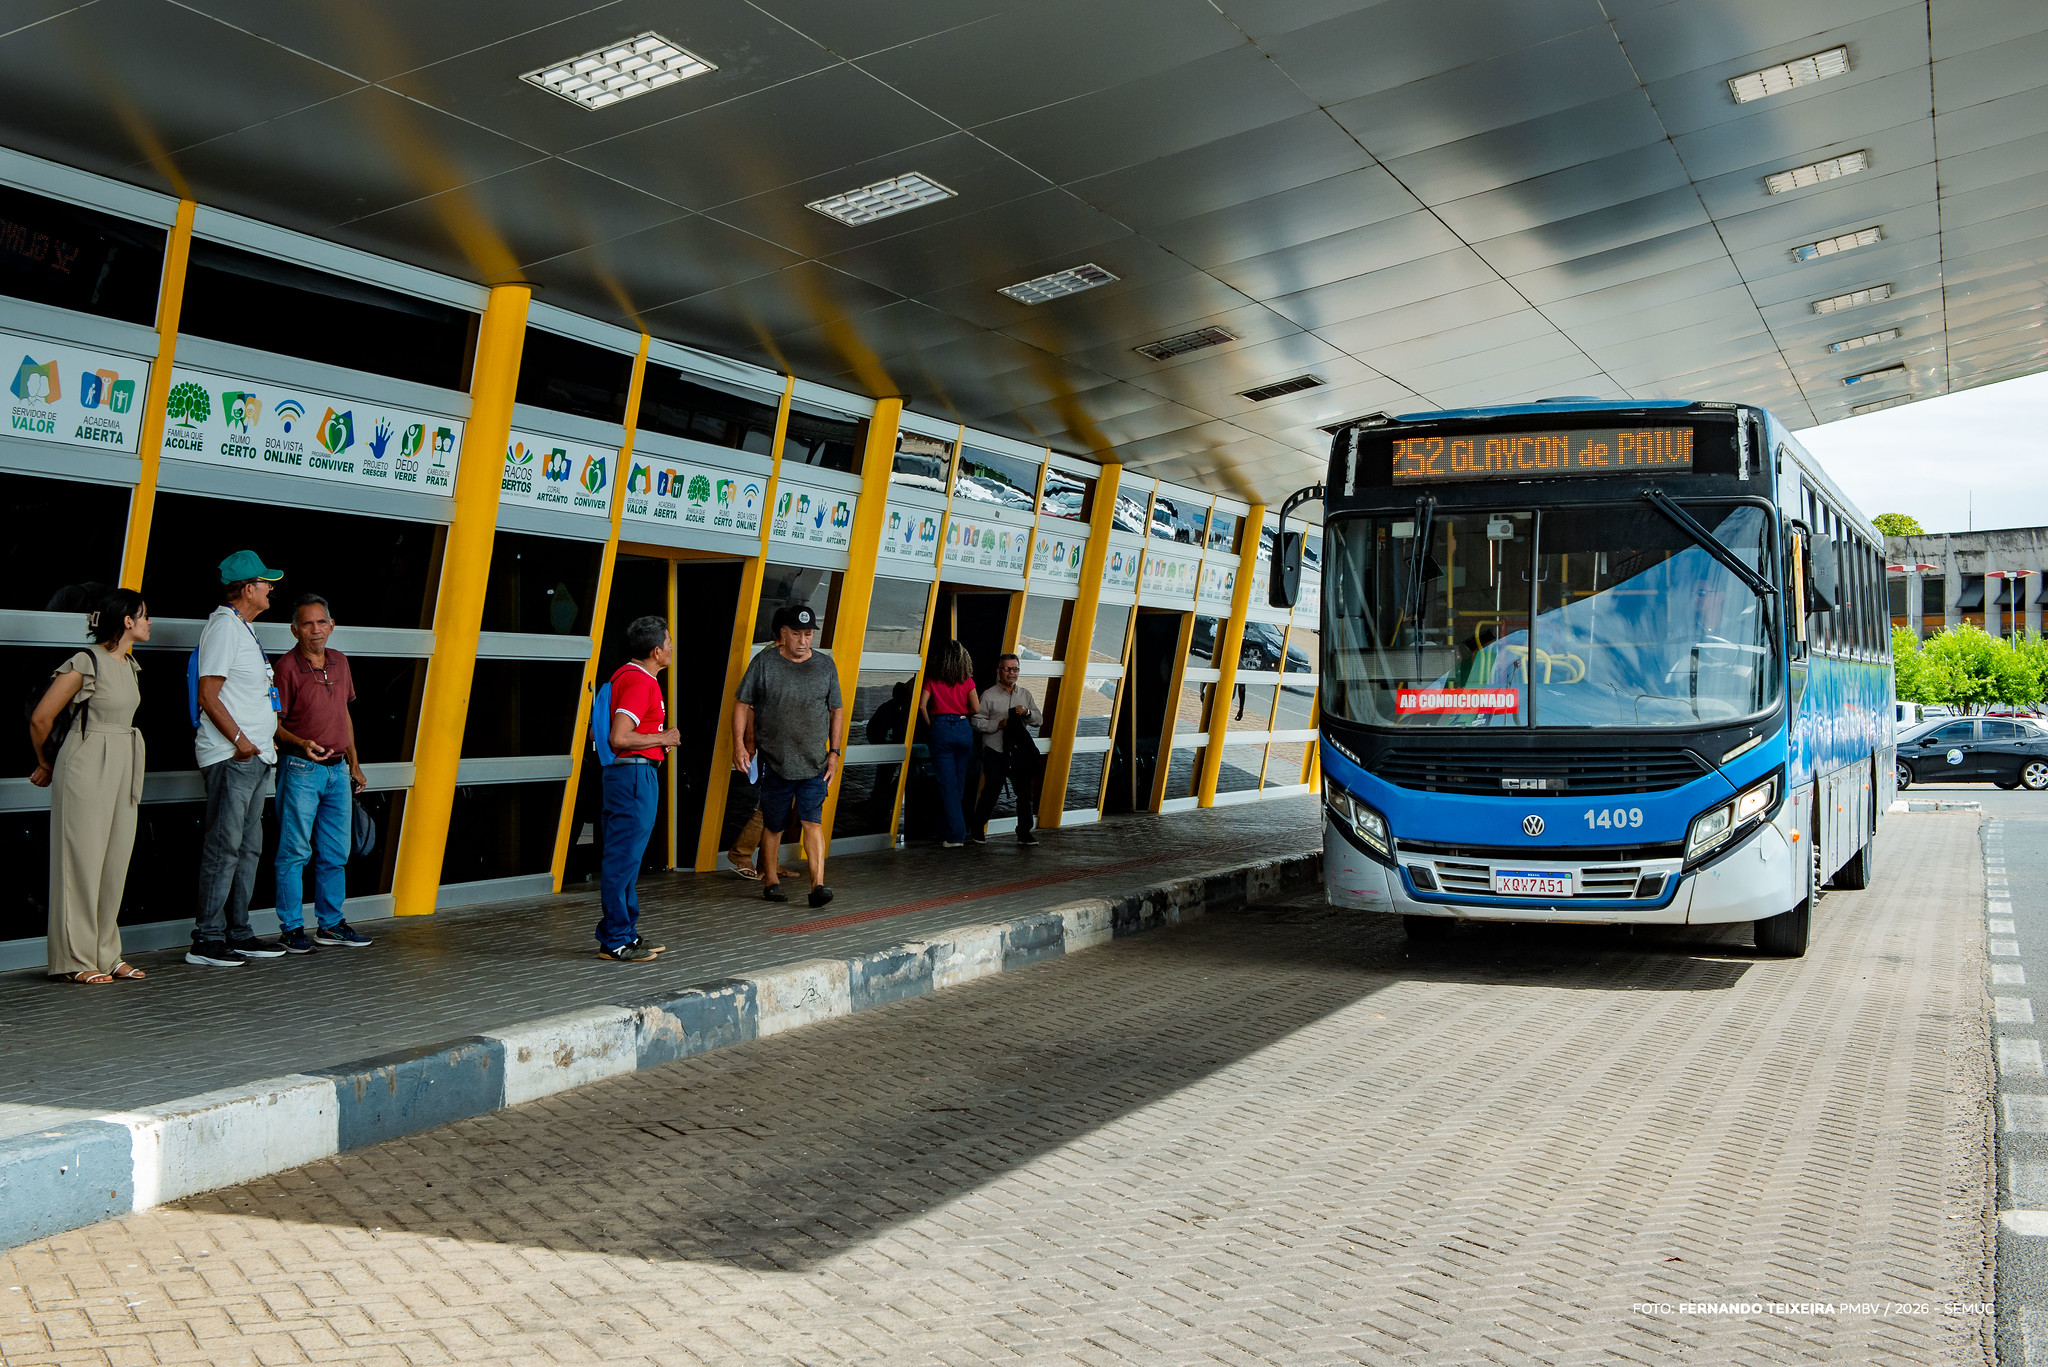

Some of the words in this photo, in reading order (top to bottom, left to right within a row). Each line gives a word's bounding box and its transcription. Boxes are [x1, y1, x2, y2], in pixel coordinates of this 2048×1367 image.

[12, 406, 46, 419] SERVIDOR
[47, 411, 57, 420] DE
[11, 415, 55, 434] VALOR
[83, 415, 120, 429] ACADEMIA
[75, 425, 123, 444] ABERTA
[191, 432, 203, 441] QUE
[230, 433, 250, 445] RUMO
[165, 437, 203, 451] ACOLHE
[265, 437, 281, 449] BOA
[283, 440, 303, 452] VISTA
[220, 443, 257, 459] CERTO
[264, 449, 302, 465] ONLINE
[1393, 436, 1444, 476] 252
[1451, 435, 1568, 471] GLAYCON
[1579, 439, 1608, 466] de
[309, 456, 354, 473] CONVIVER
[363, 459, 388, 471] PROJETO
[395, 458, 418, 473] DEDO
[362, 468, 387, 478] CRESCER
[394, 470, 417, 482] VERDE
[504, 464, 532, 481] RACOS
[426, 475, 448, 487] PRATA
[501, 478, 531, 494] BERTOS
[537, 492, 568, 504] ARTCANTO
[574, 496, 606, 509] CONVIVER
[626, 503, 647, 515] VALOR
[653, 508, 677, 520] ABERTA
[685, 513, 705, 524] ACOLHE
[713, 516, 732, 527] CERTO
[737, 511, 747, 519] BOA
[747, 513, 757, 521] VISTA
[736, 520, 756, 531] ONLINE
[774, 519, 788, 529] DEDO
[773, 528, 786, 537] VERDE
[791, 530, 804, 539] PRATA
[1400, 694, 1416, 708] AR
[1420, 693, 1514, 708] CONDICIONADO
[1584, 808, 1644, 829] 1409
